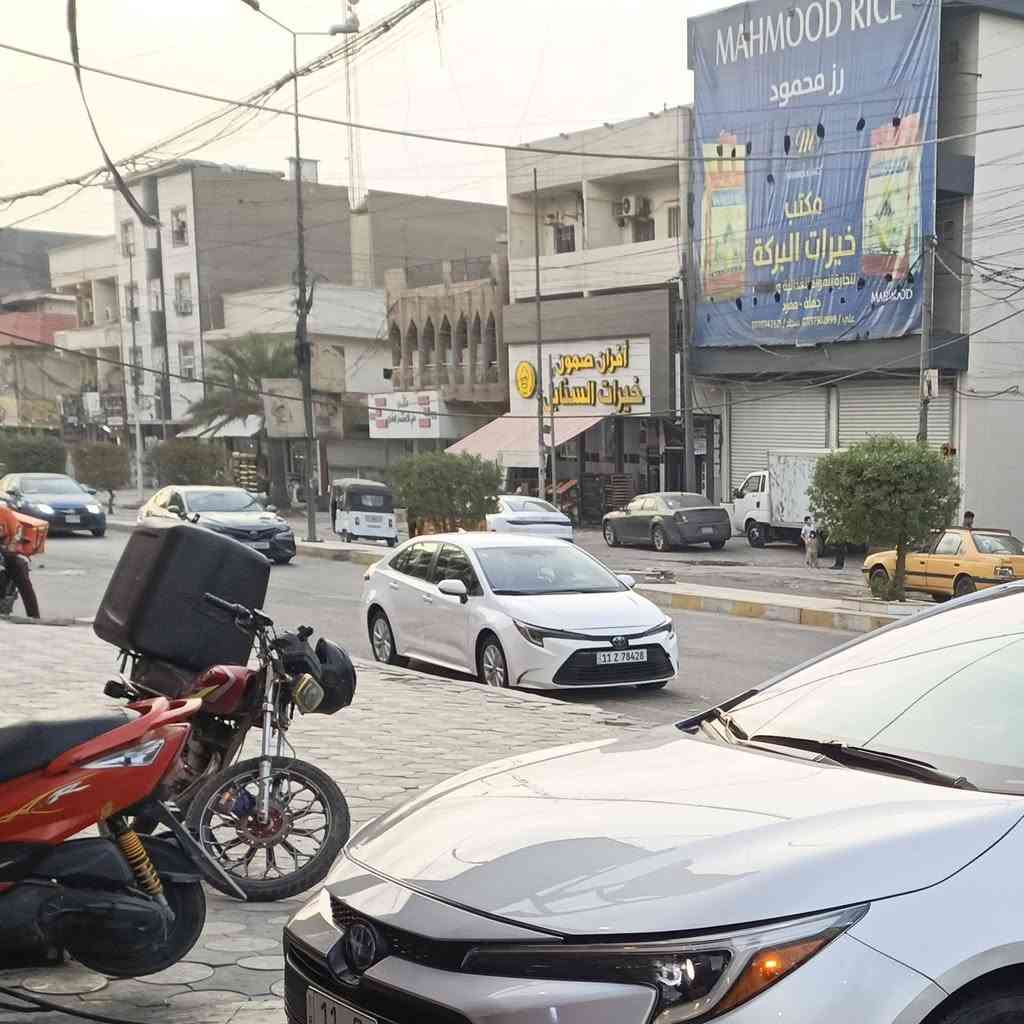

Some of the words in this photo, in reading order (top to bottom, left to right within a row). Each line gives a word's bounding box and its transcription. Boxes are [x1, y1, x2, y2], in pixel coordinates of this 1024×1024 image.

[715, 0, 842, 65] MAHMOOD
[769, 73, 825, 107] محمود
[828, 63, 845, 97] رز
[784, 191, 823, 227] مكتب
[752, 231, 801, 275] البركة
[804, 225, 857, 269] خيرات
[598, 375, 646, 413] خيرات
